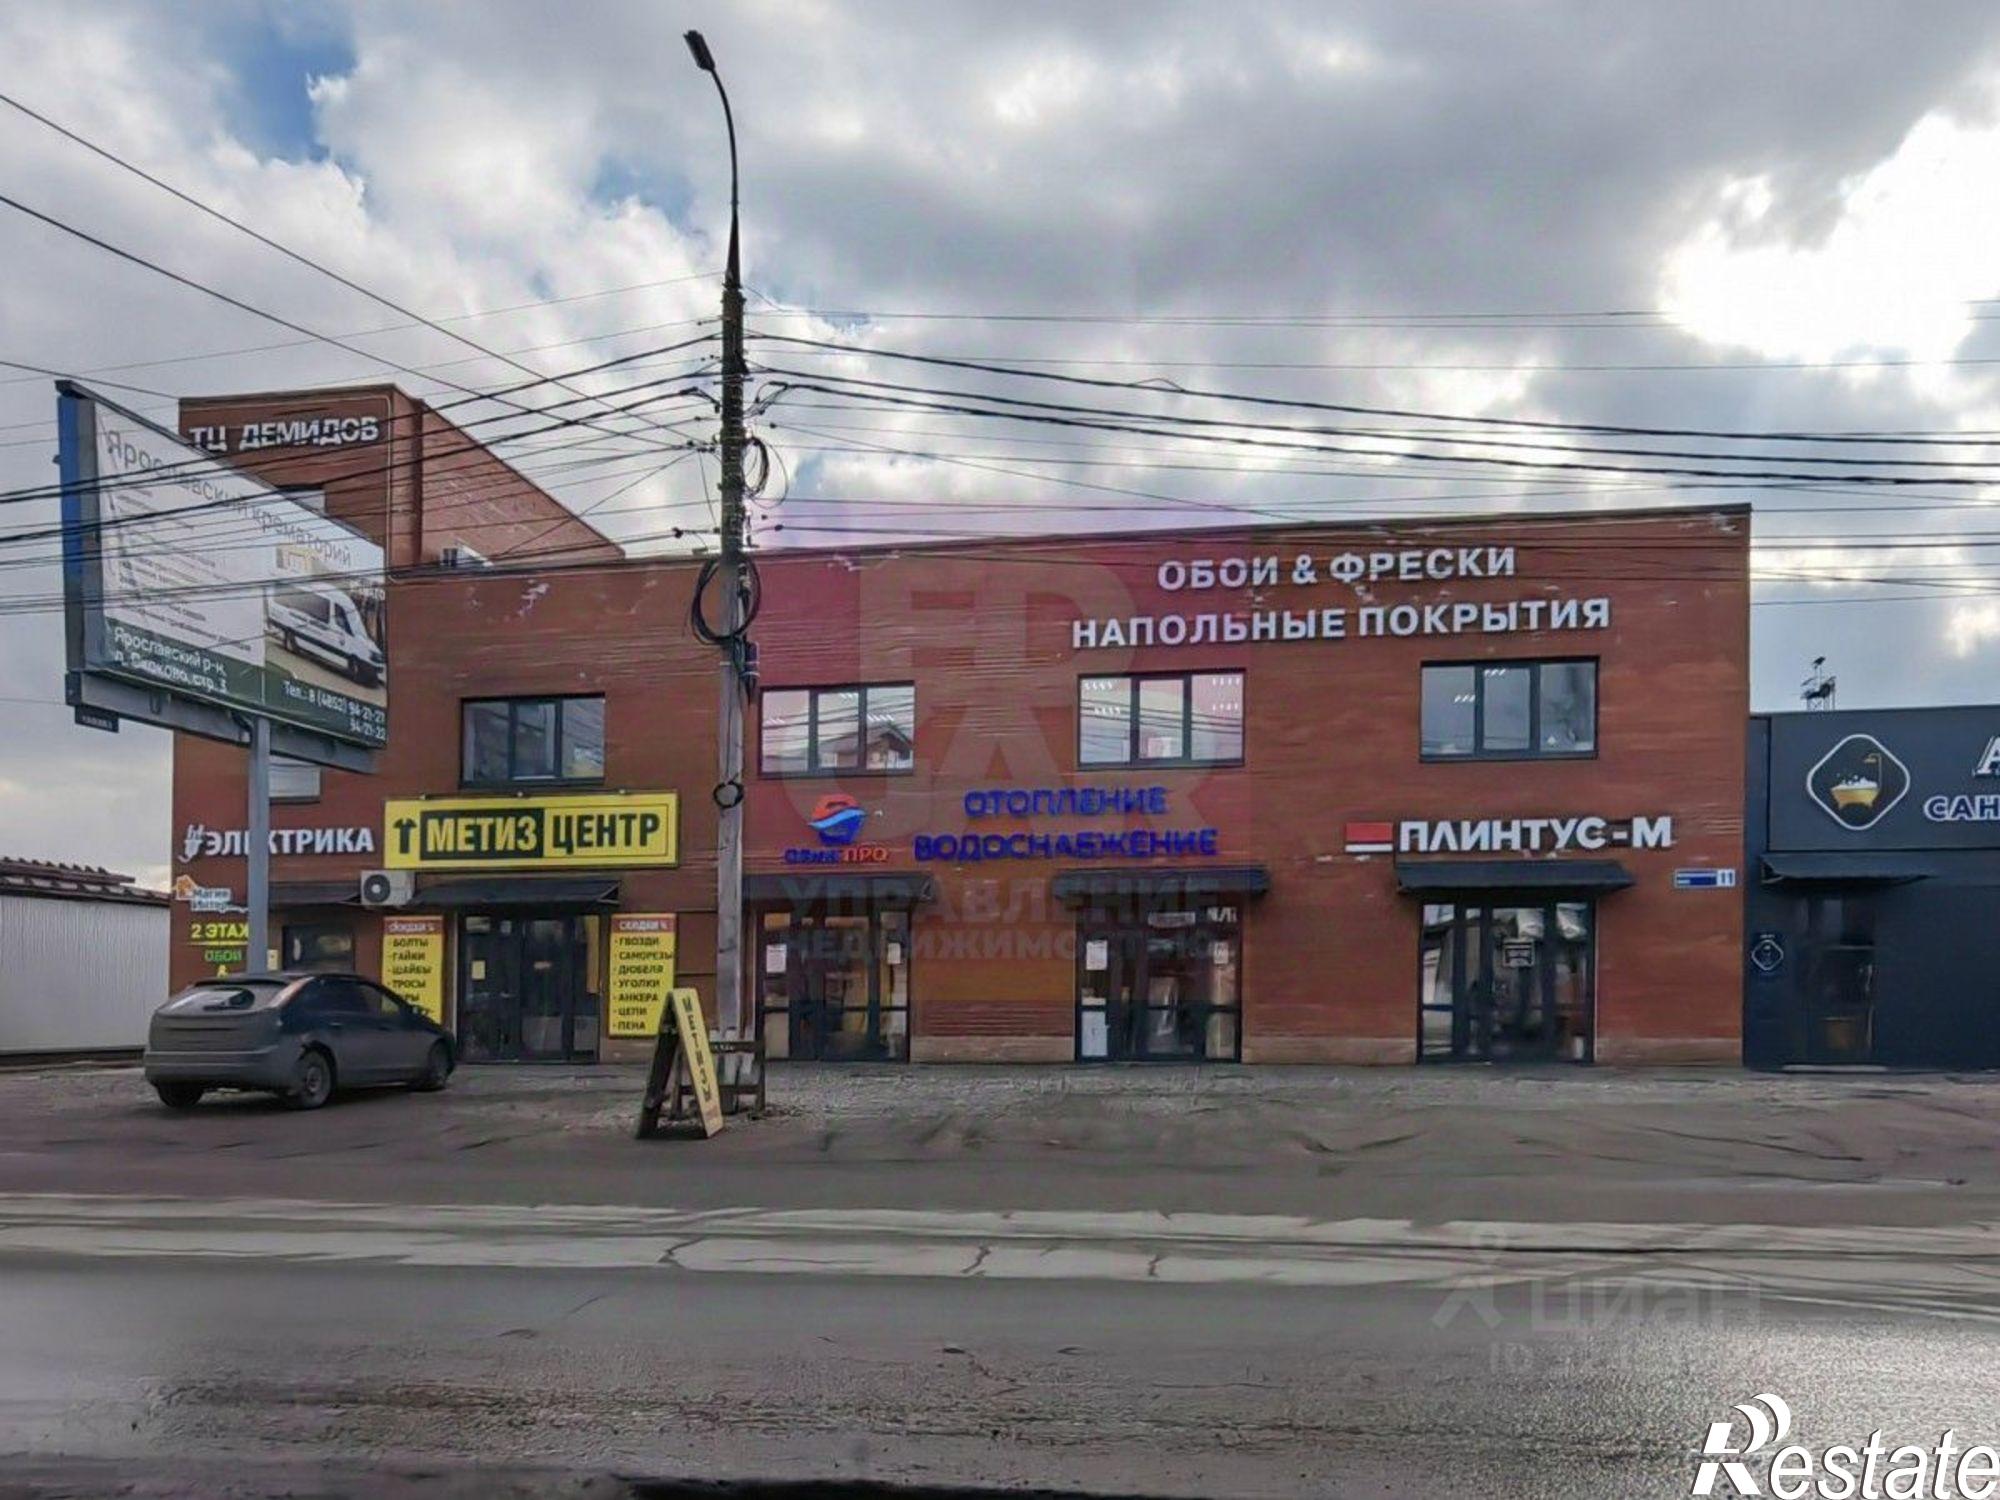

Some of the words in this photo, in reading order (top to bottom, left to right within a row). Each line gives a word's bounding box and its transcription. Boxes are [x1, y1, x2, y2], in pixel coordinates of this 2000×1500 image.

[188, 426, 228, 451] ТЦ
[239, 416, 379, 450] ДЕМИДОВ
[1157, 556, 1279, 591] ОБОИ
[1291, 552, 1319, 586] &
[1329, 545, 1516, 585] ФРЕСКИ
[1071, 606, 1346, 649] НАПОЛЬНЫЕ
[1358, 598, 1611, 638] ПОКРЫТИЯ
[963, 786, 1168, 818] ОТОПЛЕНИЕ
[426, 815, 538, 852] МЕТИЗ
[552, 813, 661, 856] ЦЕНТР
[1399, 816, 1673, 852] ПЛИНТУС-М
[204, 828, 375, 856] ЭЛКТРИКА
[914, 829, 1218, 862] ВОДОСНАБЖЕНИЕ
[1720, 871, 1734, 885] 11
[191, 923, 202, 939] 2
[393, 938, 428, 948] БОЛТЫ
[619, 936, 660, 947] ГВОЗДИ
[204, 949, 242, 962] ОБОИ
[392, 951, 426, 961] ГАЙКИ
[619, 951, 673, 961] САМОРЕЗЫ
[618, 964, 665, 975] ДЮБЕЛЯ
[618, 979, 661, 989] УГОЛКИ
[618, 993, 659, 1002] АНКЕРА
[618, 1007, 648, 1017] ЦЕПИ
[617, 1021, 647, 1031] ПЕНА
